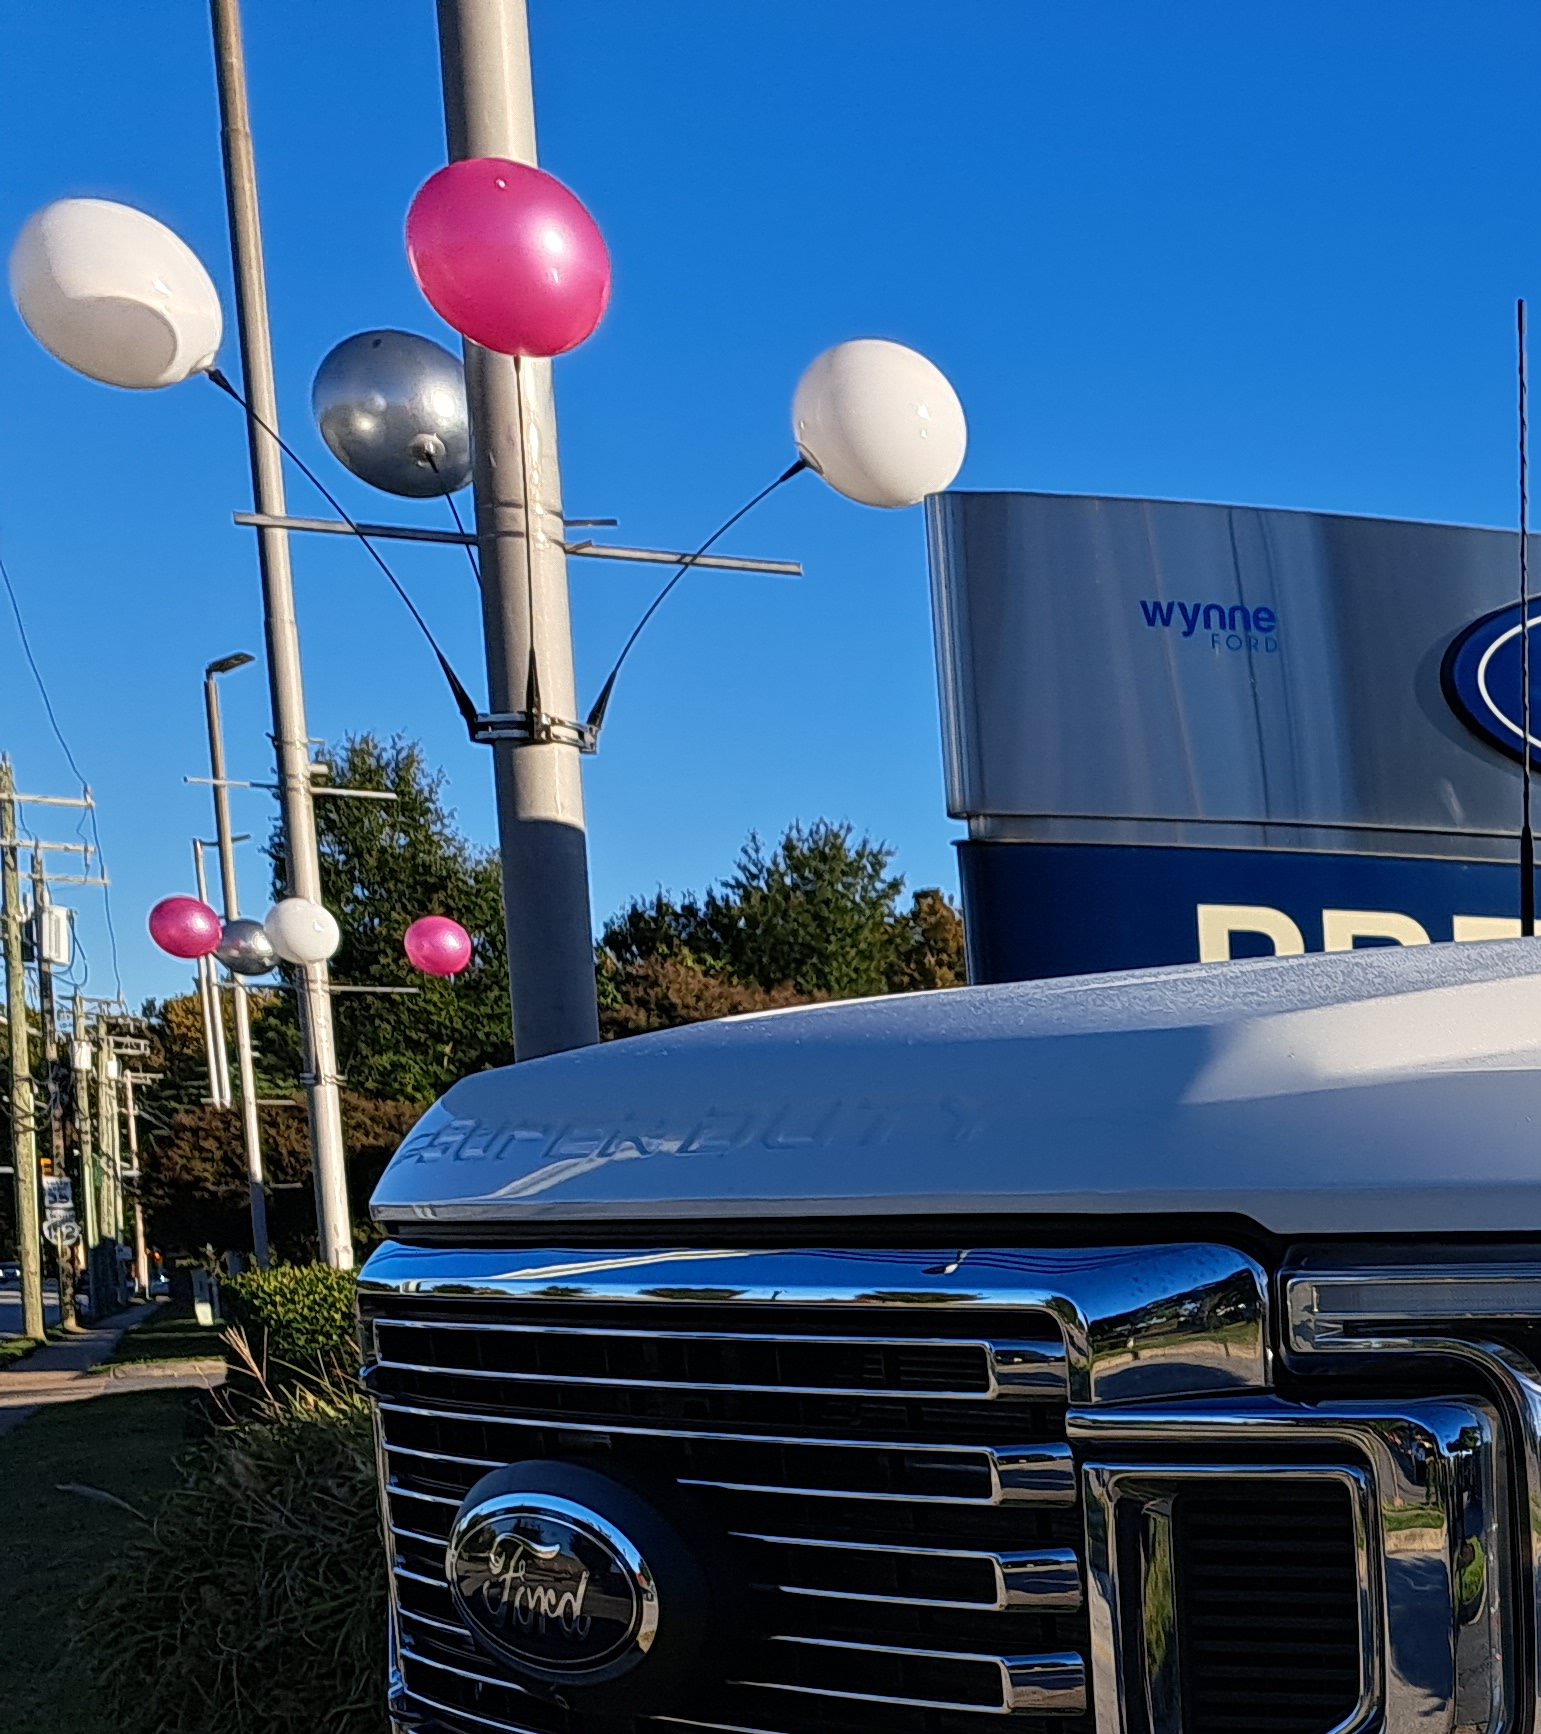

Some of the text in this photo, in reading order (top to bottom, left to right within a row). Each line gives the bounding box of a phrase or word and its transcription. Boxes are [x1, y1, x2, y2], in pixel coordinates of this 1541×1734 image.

[1139, 599, 1277, 638] wynne
[1211, 633, 1278, 653] FORD
[483, 1532, 591, 1642] Ford
